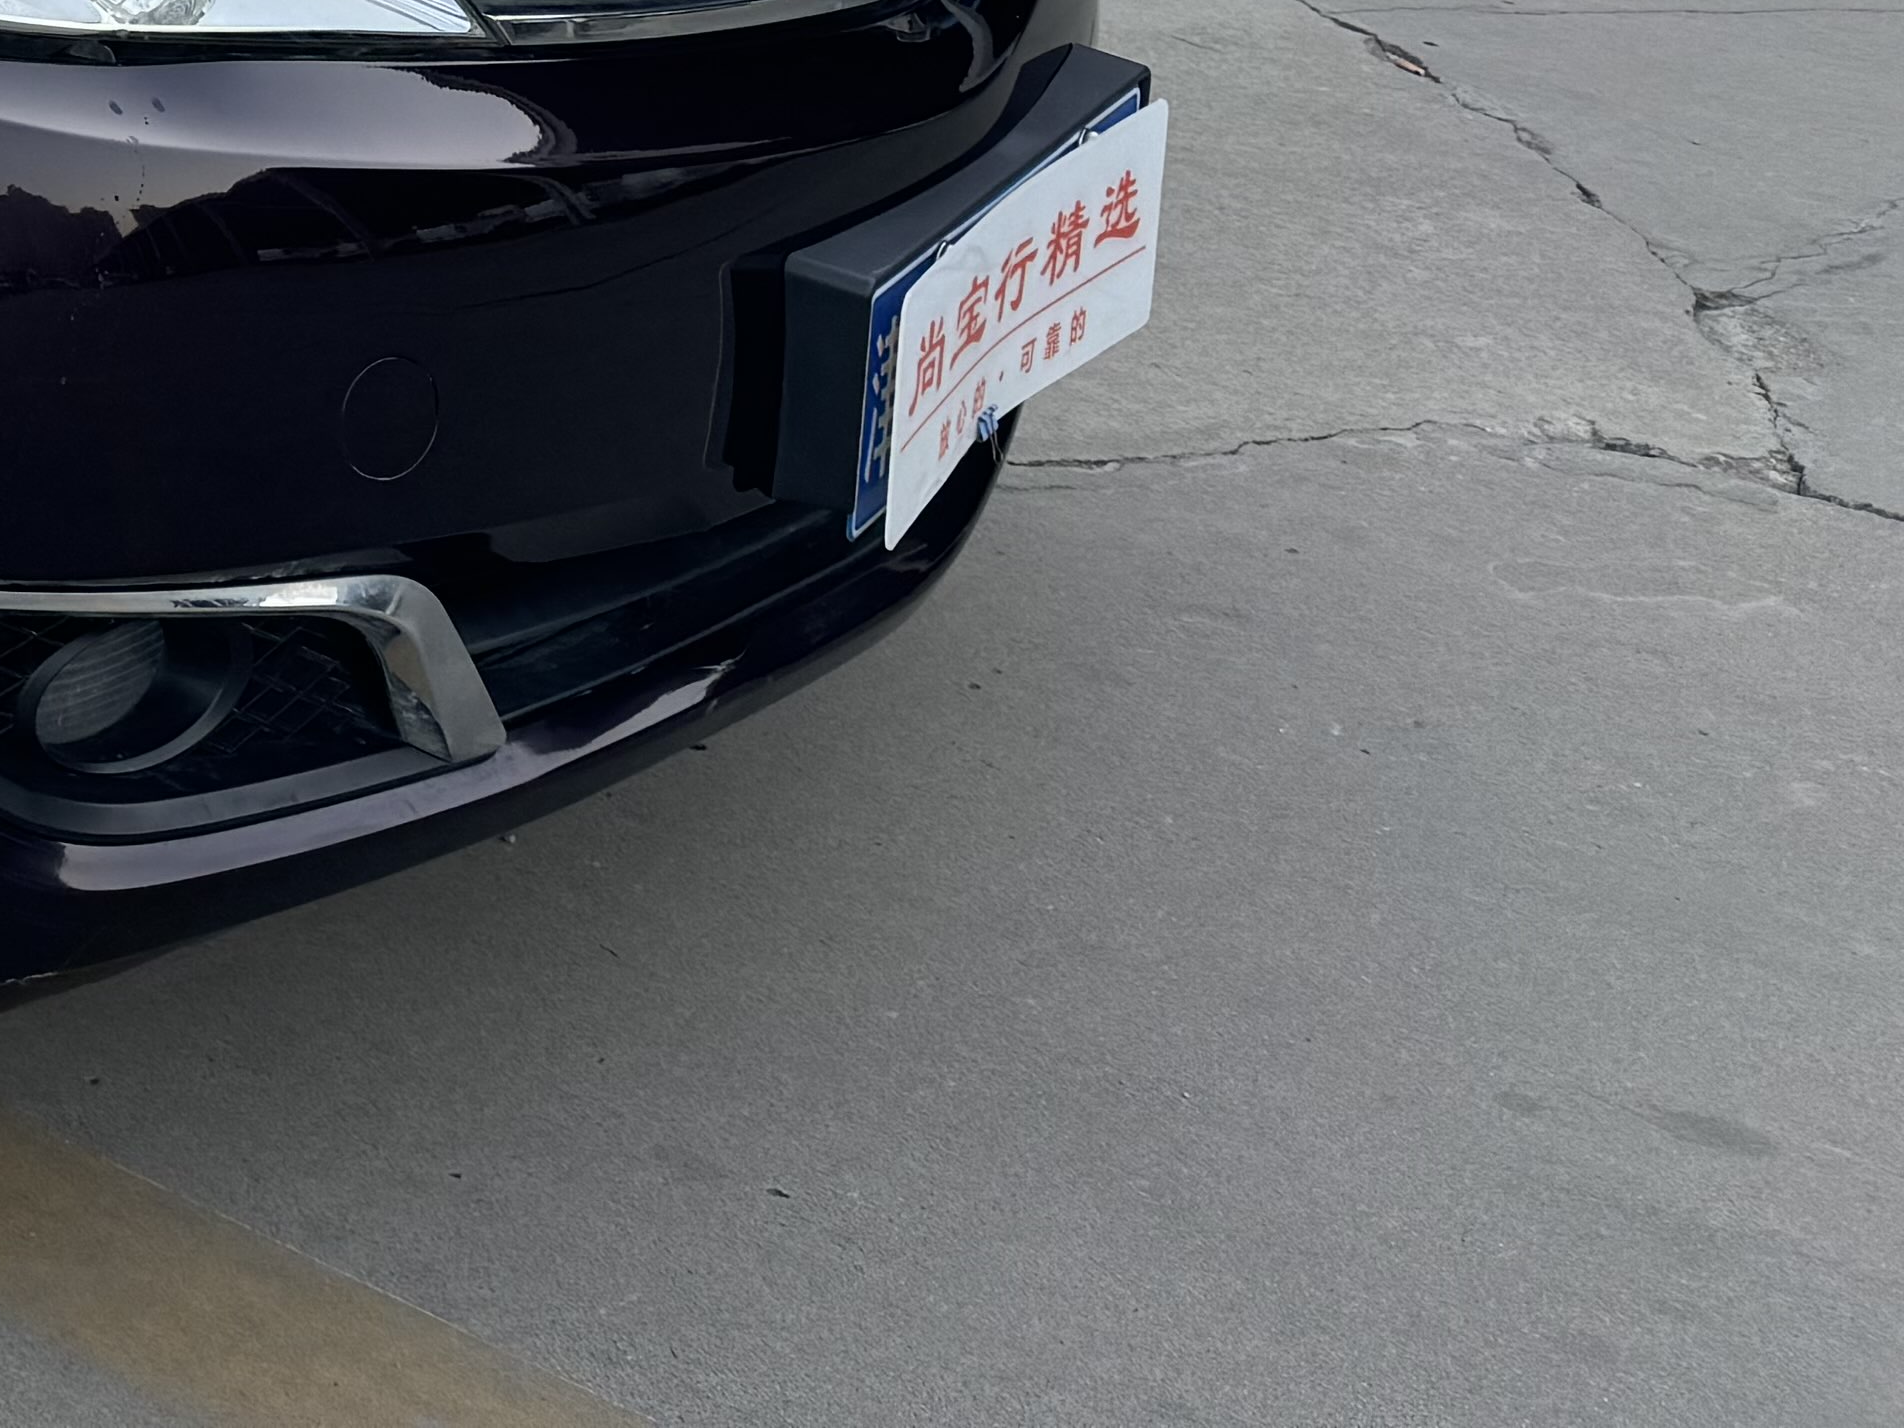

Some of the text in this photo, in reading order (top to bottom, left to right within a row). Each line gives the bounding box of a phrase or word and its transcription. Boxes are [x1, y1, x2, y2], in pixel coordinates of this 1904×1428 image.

[908, 169, 1141, 417] 尚宝行精选
